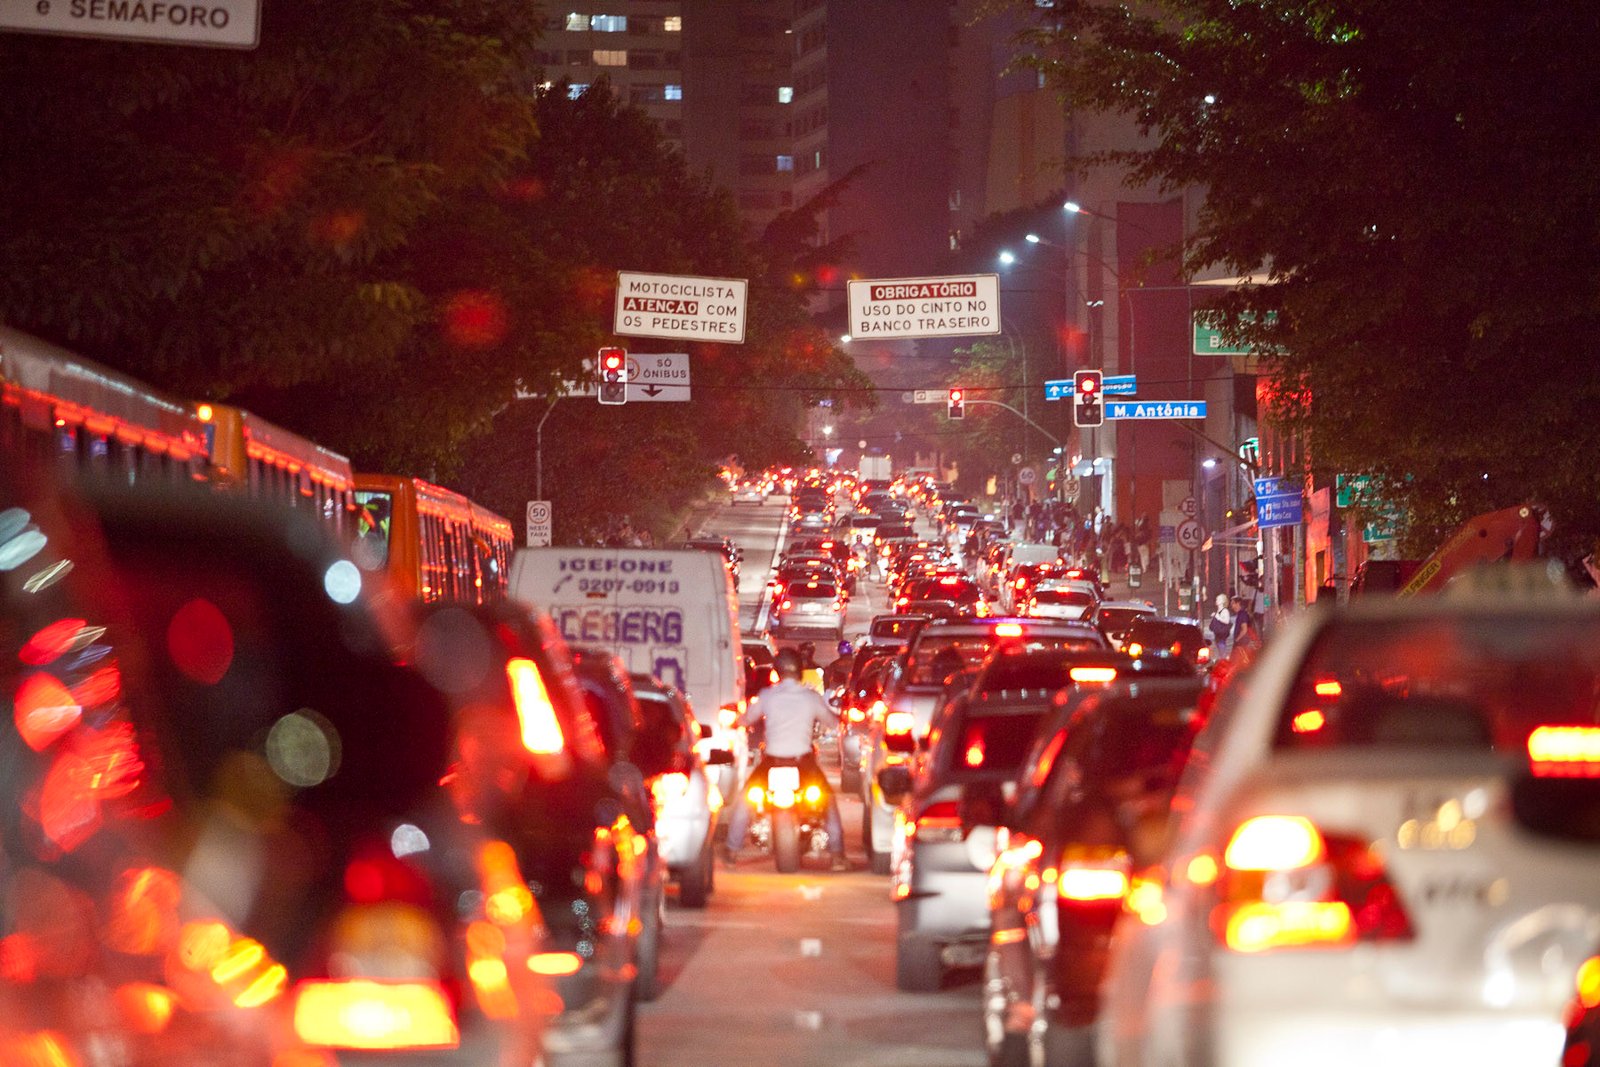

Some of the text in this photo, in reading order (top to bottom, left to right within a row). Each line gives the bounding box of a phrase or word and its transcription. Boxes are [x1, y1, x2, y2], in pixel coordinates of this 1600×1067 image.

[629, 282, 735, 300] MOTOCICLISTA
[875, 282, 974, 300] OBRIGATÓRIO
[706, 304, 737, 317] COM
[862, 300, 987, 316] USO DO CINTO NO
[623, 315, 737, 334] OS PEDESTRES
[860, 316, 990, 333] BANCO TRASEIRO
[643, 367, 687, 379] ÔNIBUS
[1114, 403, 1199, 417] M. Antônia
[532, 507, 546, 518] 50
[1182, 527, 1200, 540] 60
